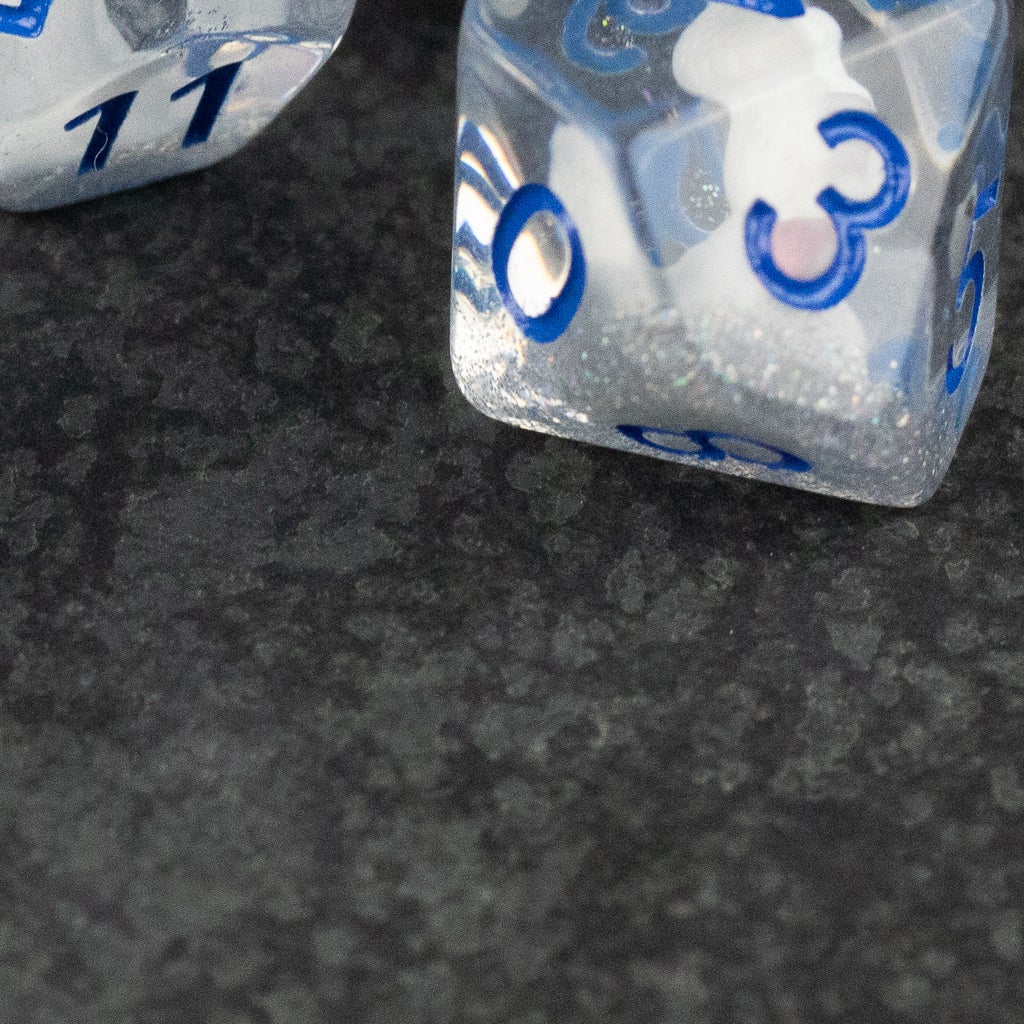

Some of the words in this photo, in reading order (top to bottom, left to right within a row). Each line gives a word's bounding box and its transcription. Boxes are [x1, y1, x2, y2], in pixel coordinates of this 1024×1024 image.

[64, 60, 245, 176] 11
[492, 183, 588, 344] 0
[744, 109, 911, 312] 3
